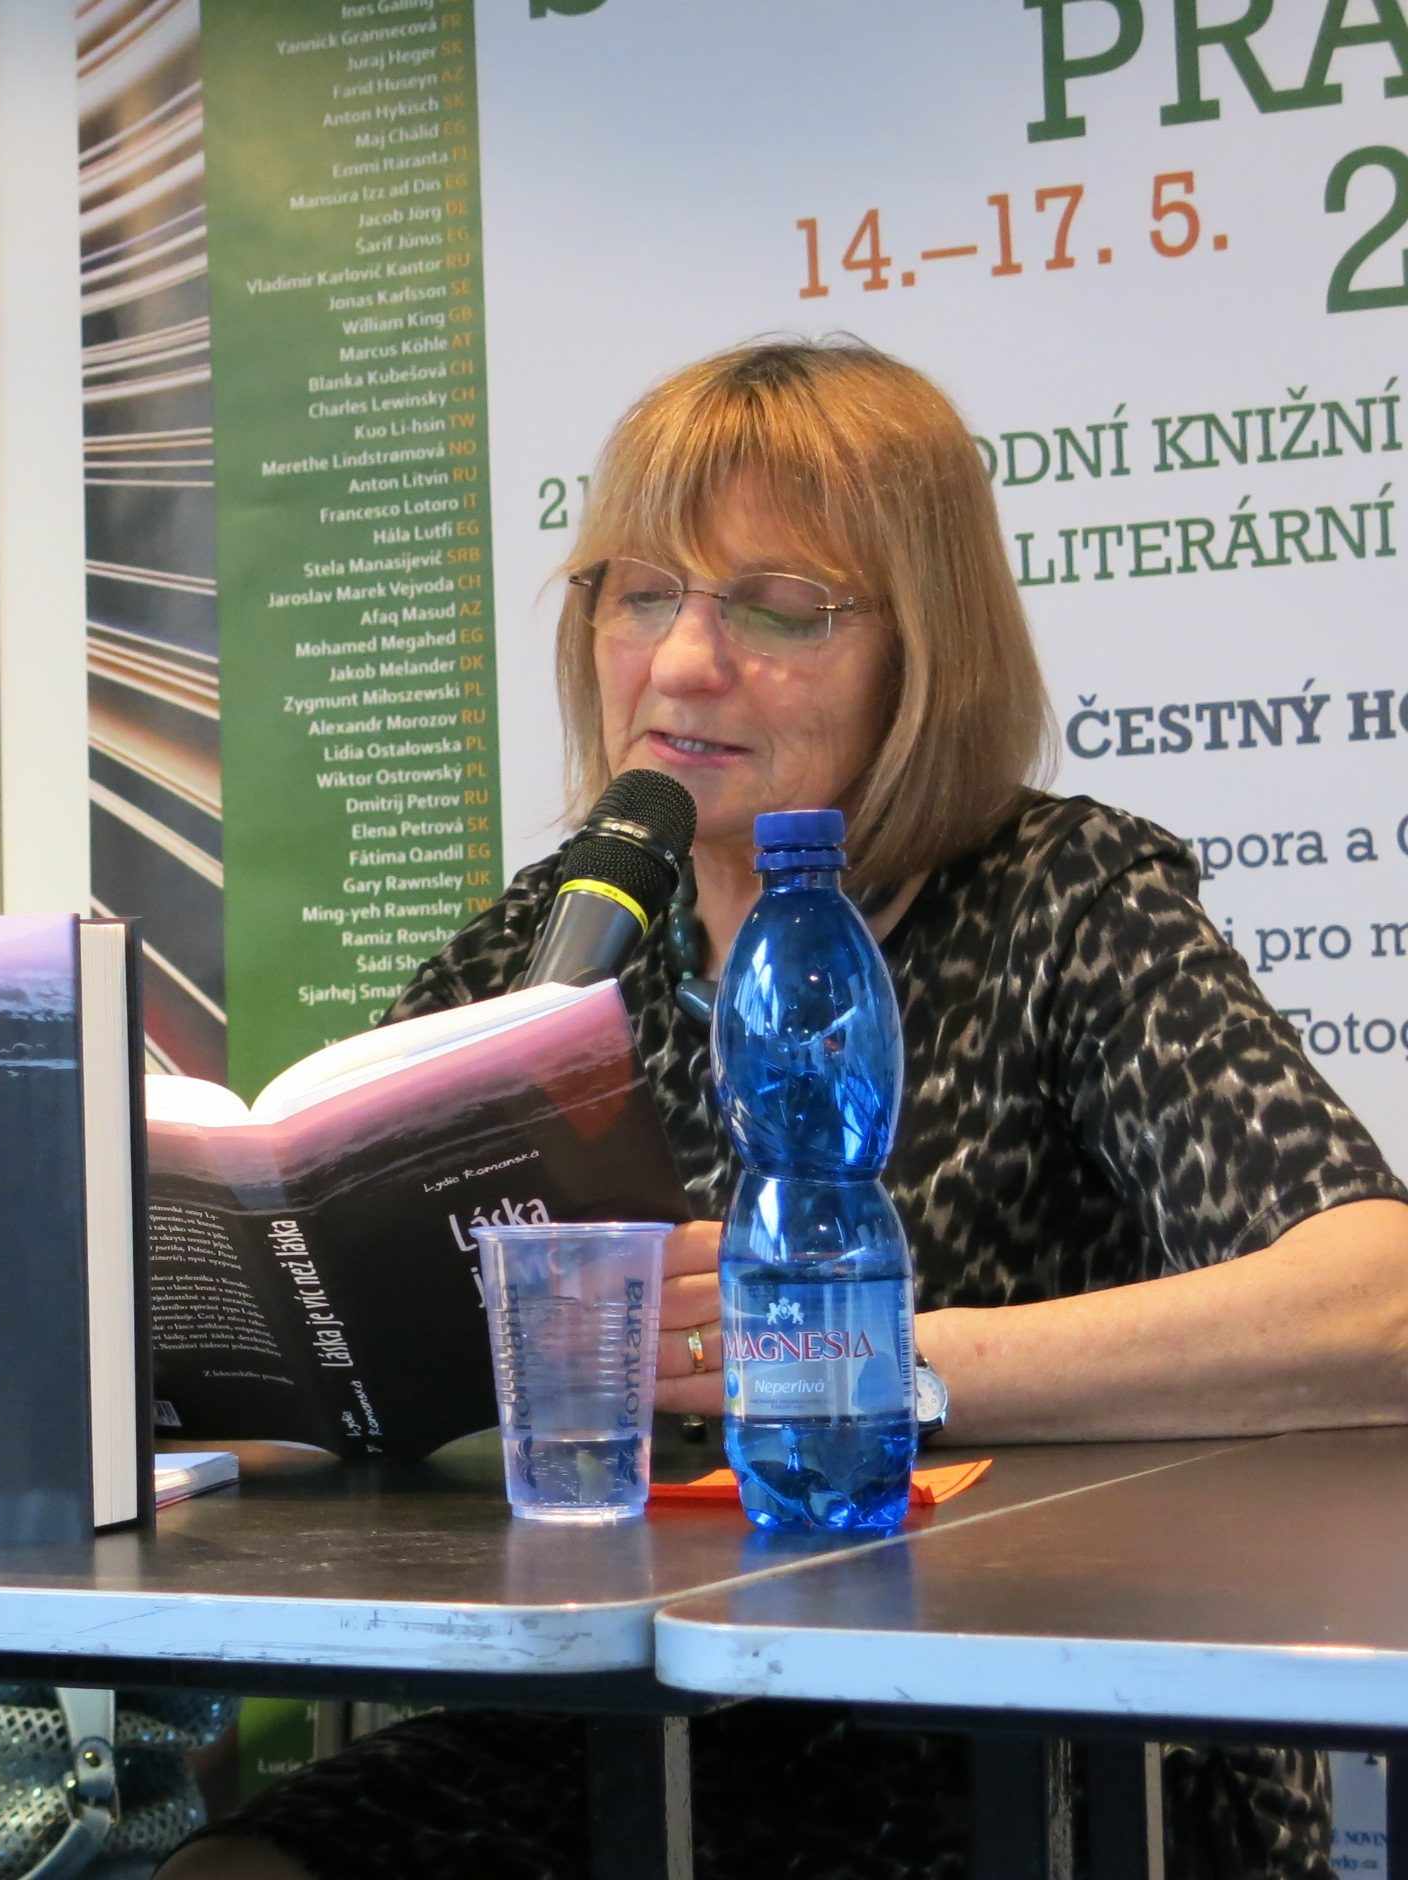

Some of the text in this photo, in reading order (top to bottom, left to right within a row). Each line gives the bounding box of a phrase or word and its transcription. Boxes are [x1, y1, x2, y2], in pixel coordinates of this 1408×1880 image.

[347, 54, 385, 72] Juraj
[388, 47, 436, 67] Heger
[323, 108, 371, 127] Anton
[375, 97, 439, 121] Hykisch
[355, 132, 385, 150] Maj
[358, 208, 404, 228] Jacob
[386, 258, 443, 278] Kantor
[446, 253, 471, 268] RU
[328, 279, 471, 312] Jonas Karlsson SE
[342, 304, 473, 335] William King GB
[339, 345, 398, 363] Marcus
[451, 333, 473, 348] AT
[308, 359, 474, 392] Blanka Kubešová CH
[308, 387, 476, 419] Charles Lewinsky CH
[354, 414, 476, 440] Kuo Li-hsin TW
[1152, 376, 1403, 473] KNIŽNÍ
[261, 456, 329, 477] Merethe
[448, 440, 477, 456] NO
[348, 466, 477, 494] Anton Litvin RU
[320, 493, 479, 524] Francesco Lotoro IT
[373, 520, 480, 545] Hála Lutfi EG
[1014, 482, 1397, 587] LITERÁRNÍ
[303, 561, 345, 579] Stela
[447, 547, 480, 565] SRB
[267, 574, 481, 608] Jaroslav Marek Vejvoda CH
[360, 601, 481, 627] Afaq Masud AZ
[295, 628, 484, 657] Mohamed Megahed EG
[328, 655, 485, 682] Jakob Melander DK
[283, 692, 358, 715] Zygmunt
[463, 682, 486, 697] PL
[308, 709, 487, 736] Alexandr Morozov RU
[1066, 678, 1331, 760] ČESTNÝ
[324, 743, 364, 762] Lidia
[465, 736, 486, 751] PL
[316, 763, 487, 789] Wiktor Ostrowský PL
[346, 790, 489, 815] Dmitrij Petrov RU
[352, 817, 489, 840] Elena Petrová SK
[349, 843, 491, 867] Fátima Qandil EG
[1191, 827, 1328, 881] pora
[1346, 827, 1378, 863] a
[343, 871, 491, 896] Gary Rawnsley UK
[302, 903, 381, 926] Ming-yeh
[384, 899, 463, 918] Rawnsley
[342, 929, 393, 947] Ramiz
[1255, 924, 1351, 973] pro
[298, 984, 356, 1006] Sjarhej
[424, 1150, 540, 1192] Lydie Romanská
[268, 1219, 354, 1367] Láska je víc než láska
[722, 1329, 874, 1362] MAGNESIA
[754, 1377, 825, 1395] Neperlivá
